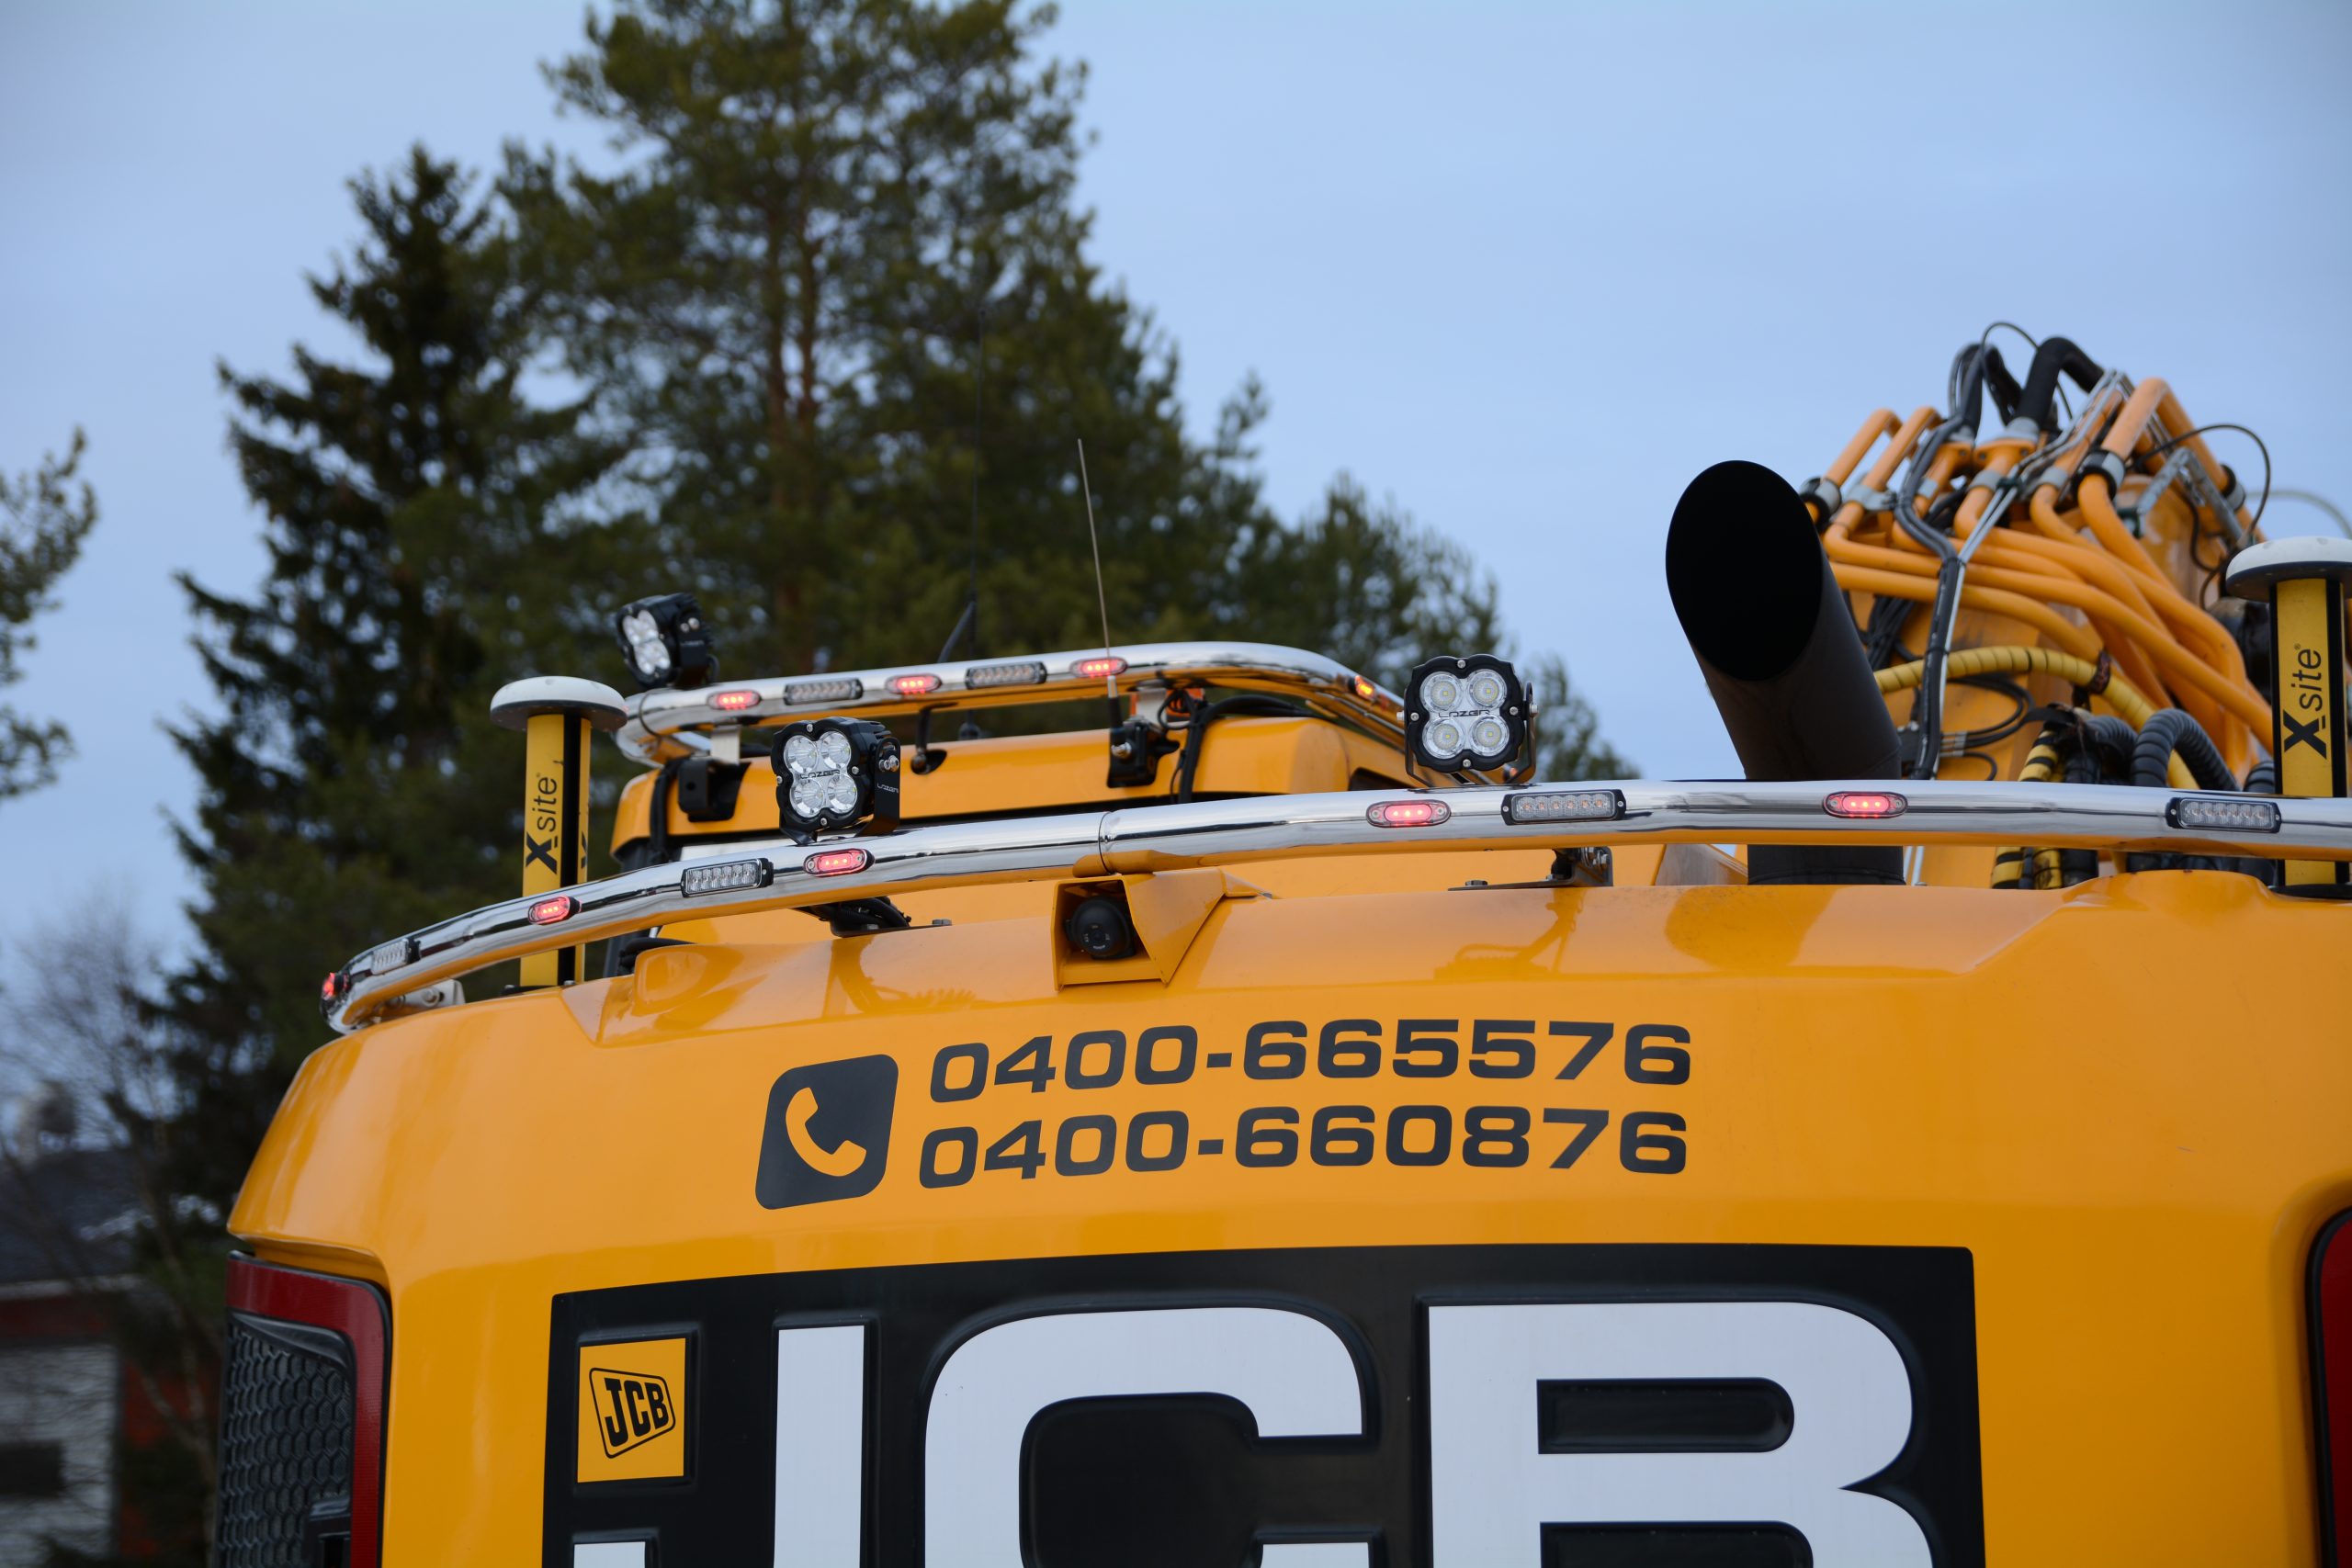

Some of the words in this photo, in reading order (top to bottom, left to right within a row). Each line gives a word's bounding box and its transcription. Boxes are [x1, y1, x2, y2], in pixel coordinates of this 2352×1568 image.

[930, 1019, 1690, 1102] 0400-665576
[919, 1105, 1687, 1189] 0400-660876
[574, 1303, 1933, 1568] JCB
[604, 1378, 670, 1447] JCB
